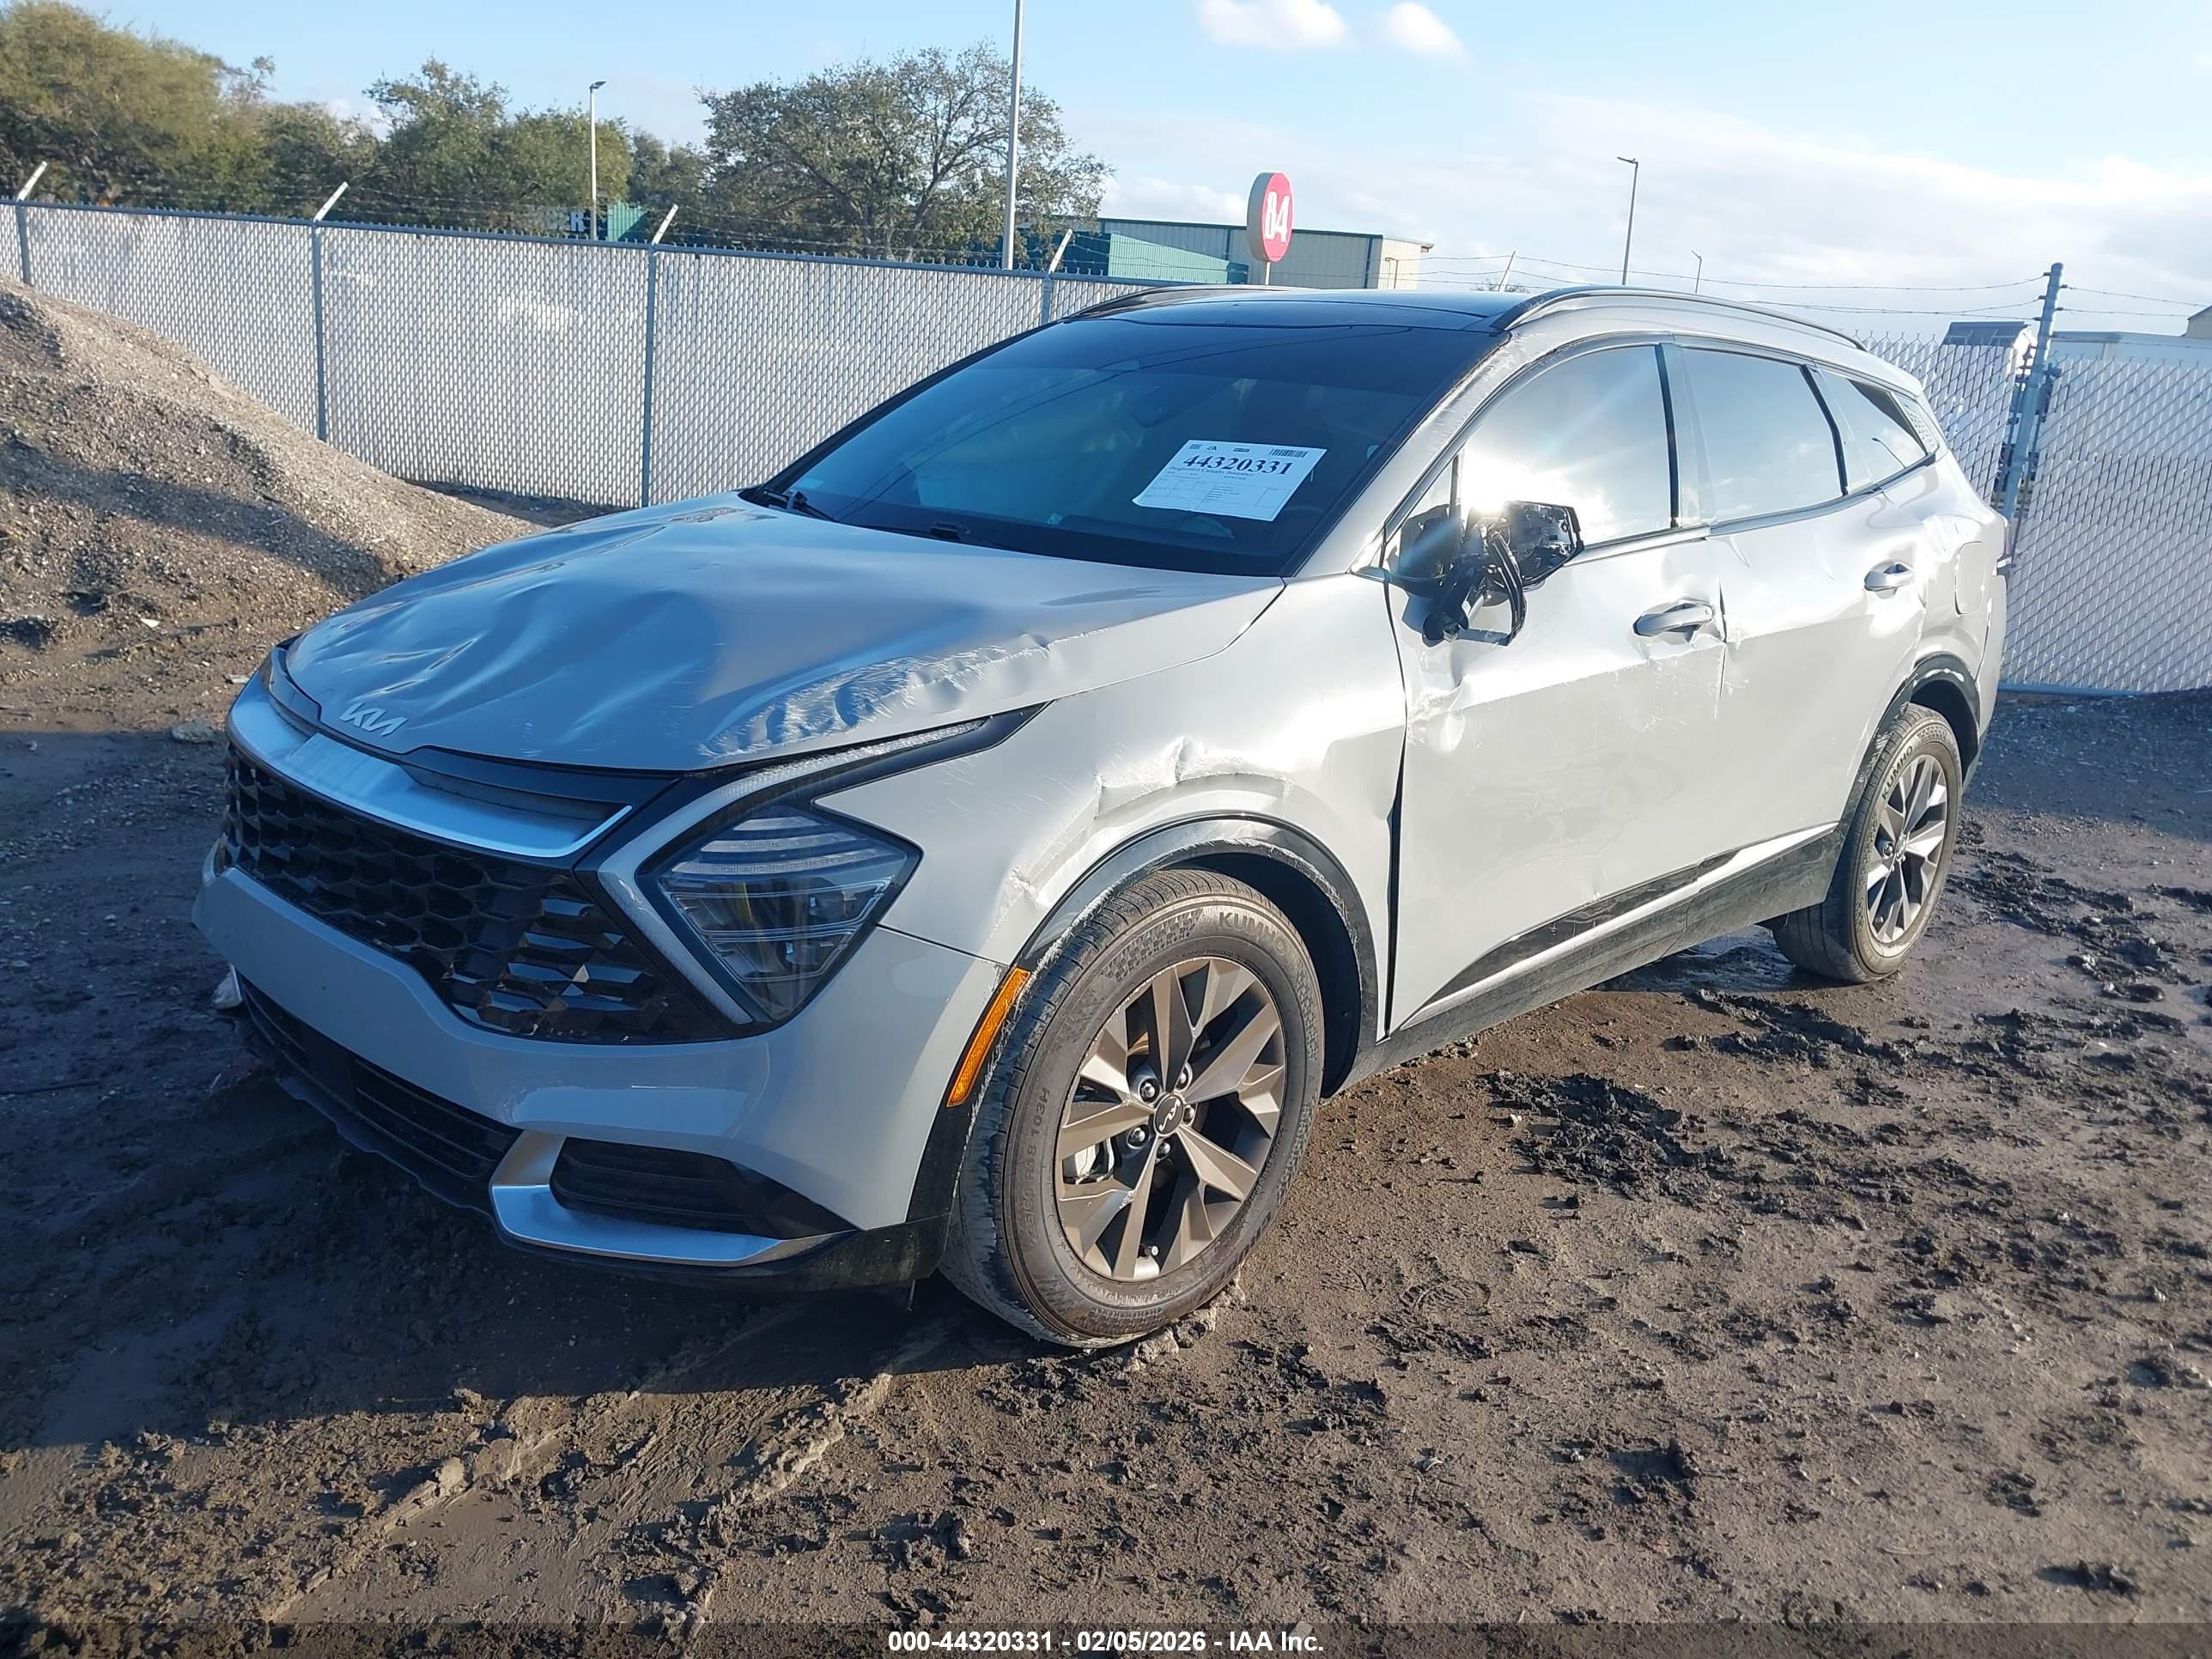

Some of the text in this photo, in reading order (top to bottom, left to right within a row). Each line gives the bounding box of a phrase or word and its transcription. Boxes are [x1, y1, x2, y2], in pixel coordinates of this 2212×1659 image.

[1265, 191, 1291, 243] 84
[1182, 454, 1293, 475] 44320331
[339, 702, 408, 737] KIA
[1881, 745, 1912, 800] KUMHO
